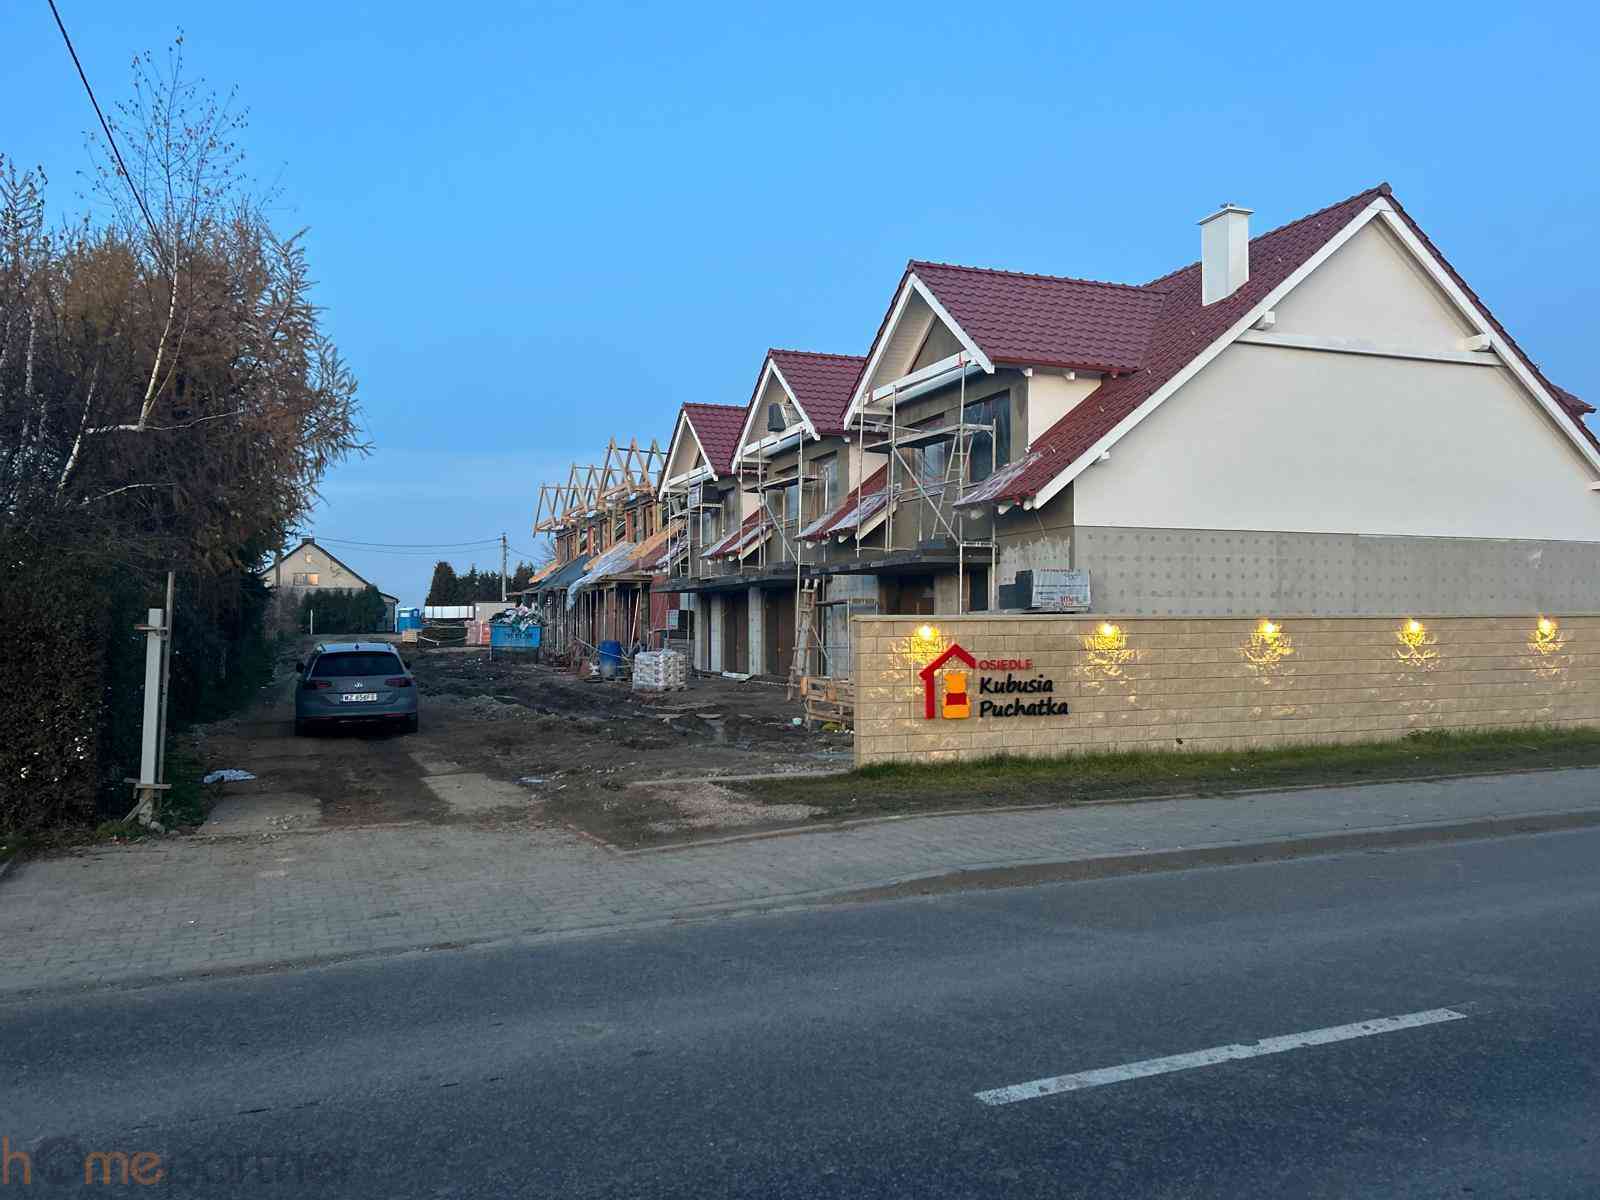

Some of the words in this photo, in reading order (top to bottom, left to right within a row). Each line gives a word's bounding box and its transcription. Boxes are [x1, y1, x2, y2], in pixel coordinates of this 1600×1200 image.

[979, 659, 1033, 671] OSIEDLE
[979, 673, 1053, 694] Kubusia
[979, 697, 1068, 718] Puchatka
